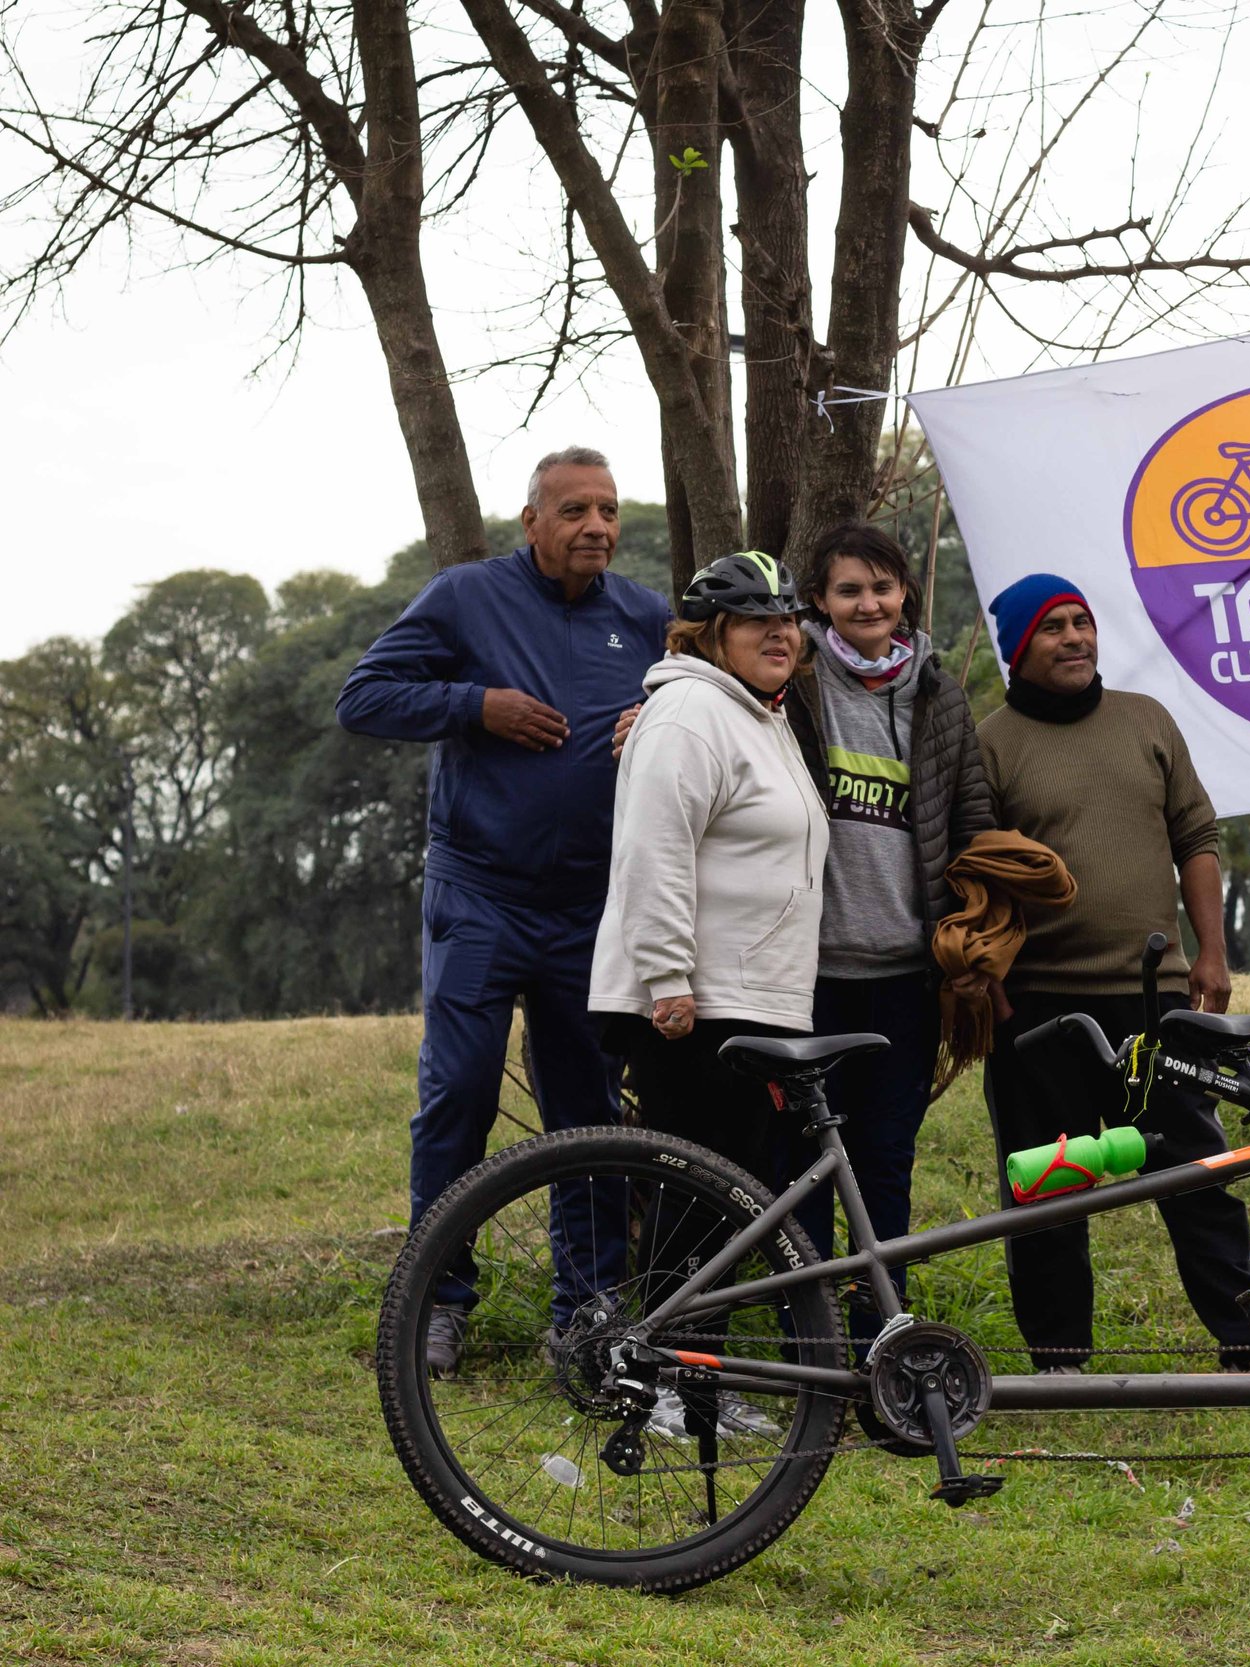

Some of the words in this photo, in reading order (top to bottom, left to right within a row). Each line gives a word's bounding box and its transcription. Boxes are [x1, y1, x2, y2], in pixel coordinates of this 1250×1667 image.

[1164, 1055, 1197, 1077] DONÁ
[728, 1186, 766, 1218] OSS
[775, 1228, 804, 1271] RAIL
